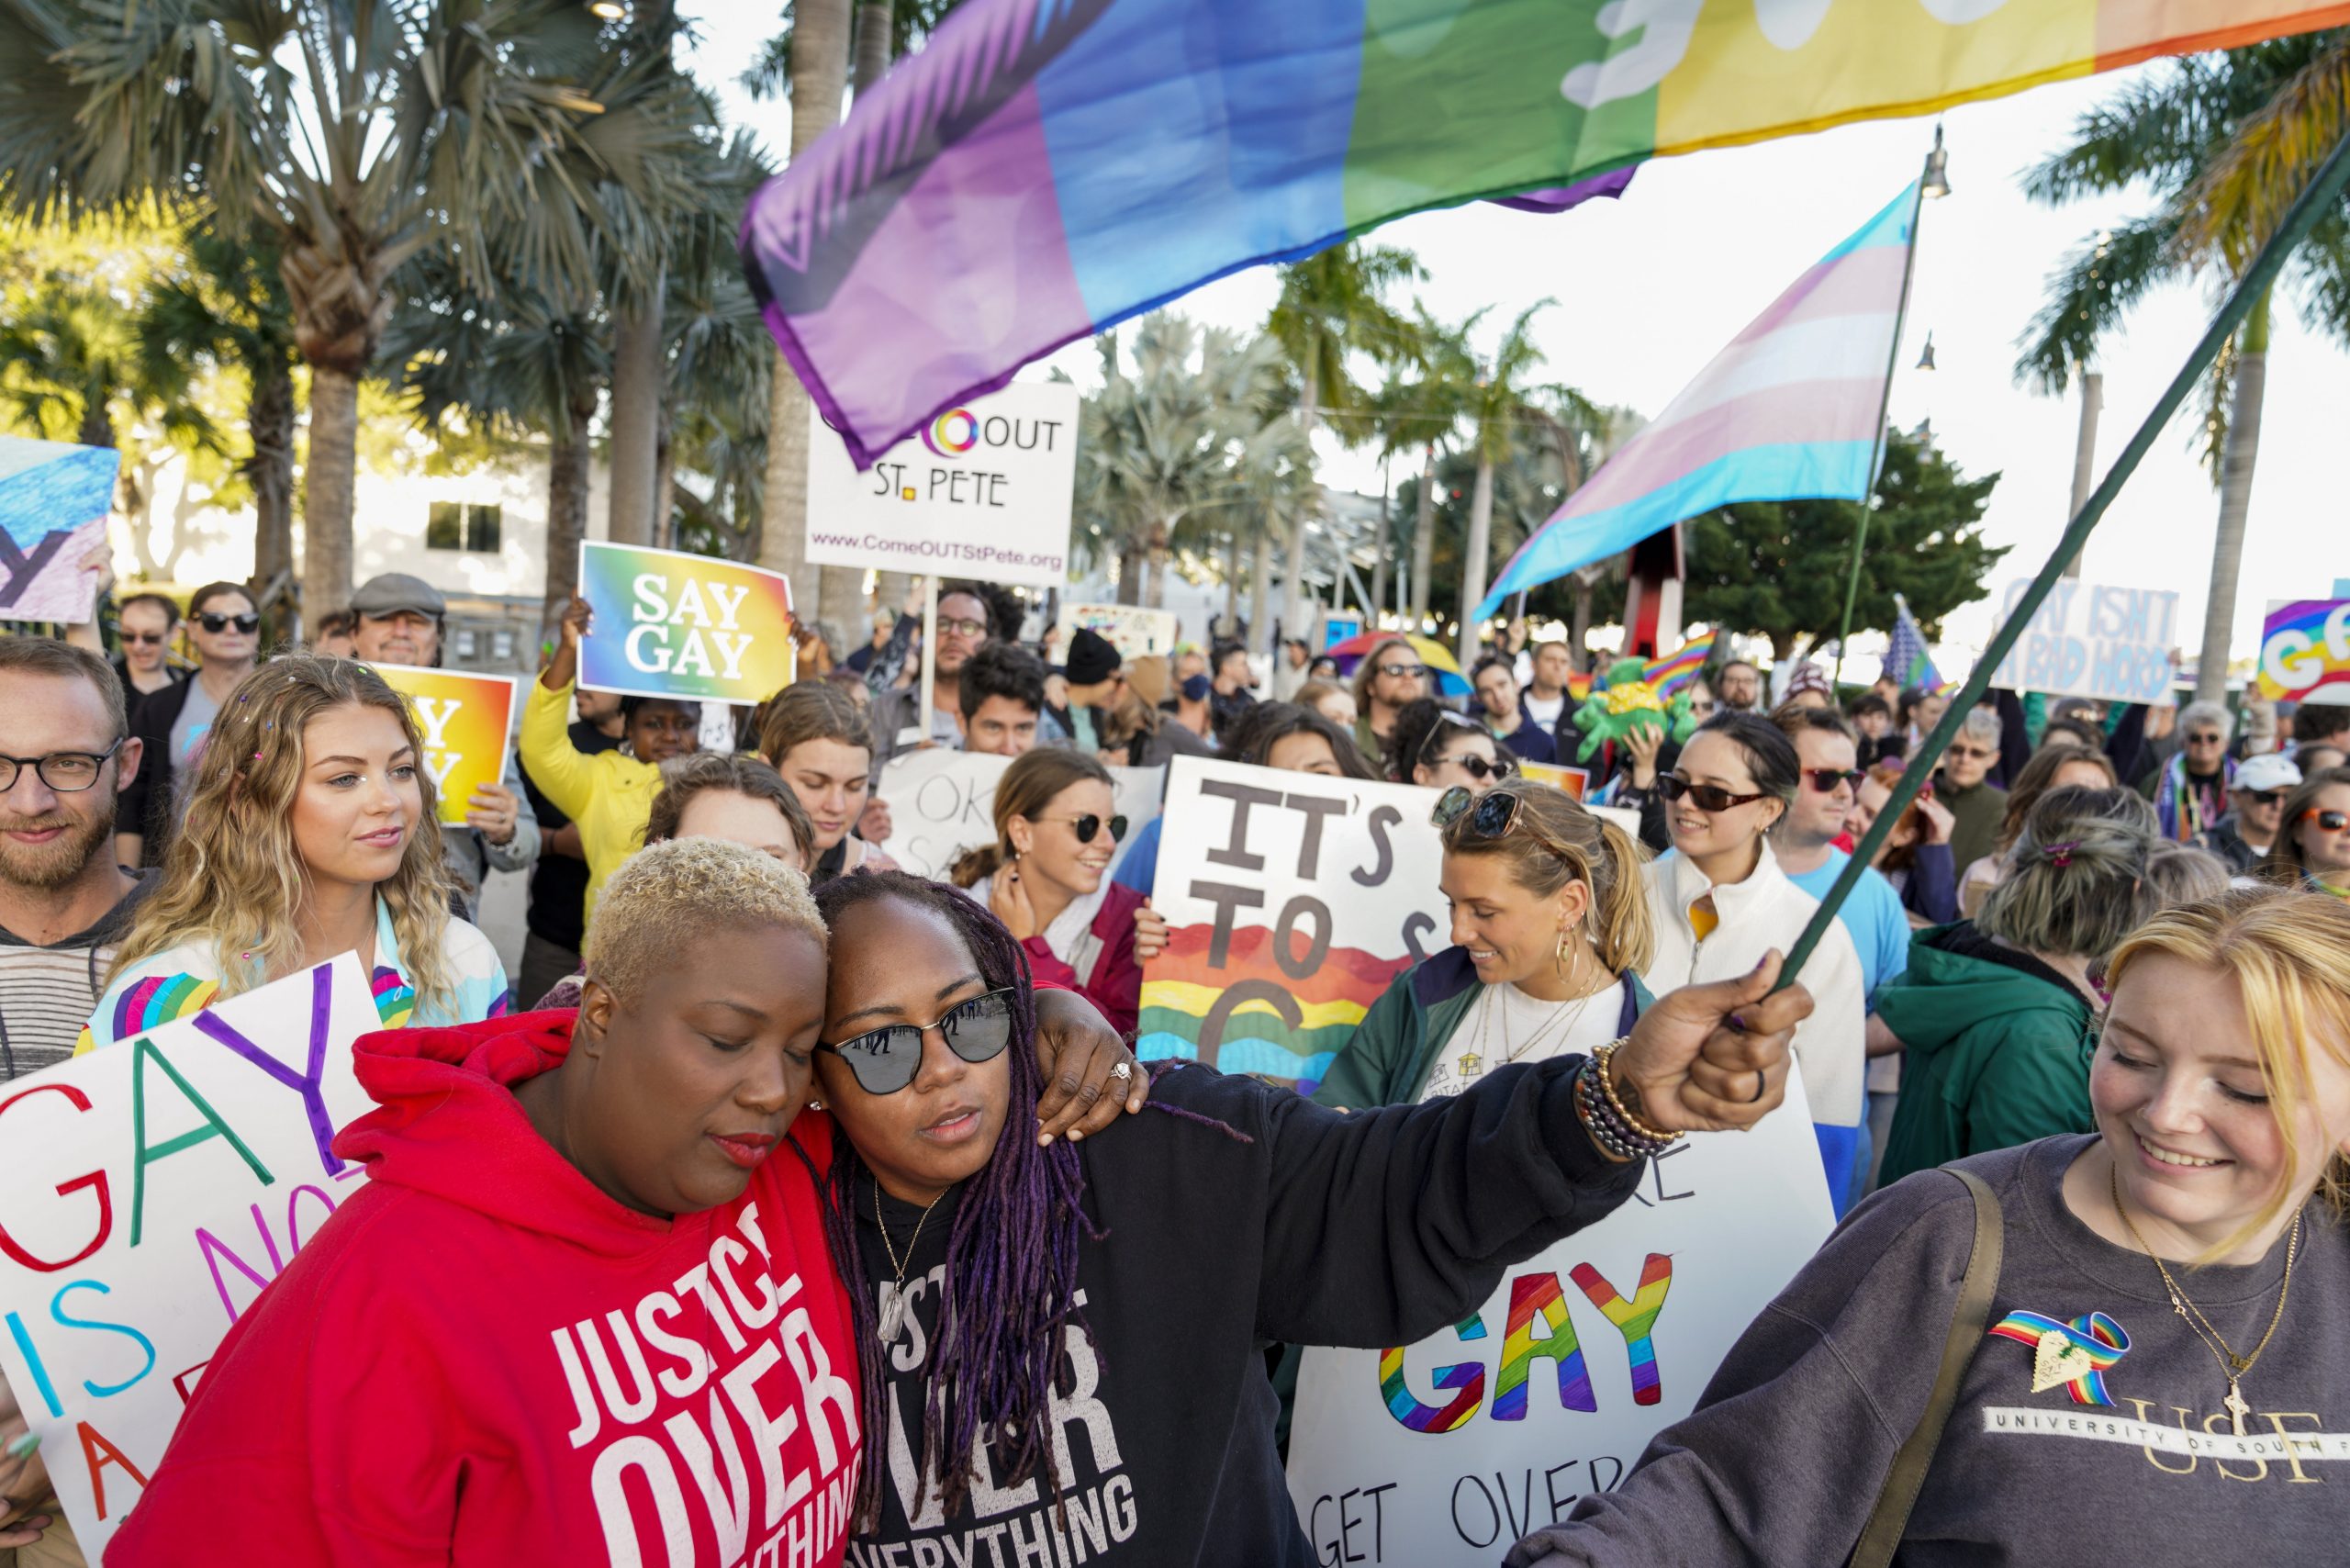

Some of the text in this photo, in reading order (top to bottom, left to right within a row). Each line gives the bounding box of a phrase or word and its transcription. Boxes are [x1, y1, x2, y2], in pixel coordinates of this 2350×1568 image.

[984, 416, 1062, 451] OUT
[874, 462, 1008, 507] ST. PETE
[811, 532, 1062, 572] www.ComeOUTStPete.org
[632, 573, 749, 631] SAY
[624, 623, 754, 680] GAY
[917, 774, 995, 826] OK
[1200, 778, 1403, 888] IT'S
[1190, 879, 1333, 980] TO
[0, 963, 346, 1272] GAY
[5, 1165, 367, 1418] IS NO
[1379, 1252, 1674, 1434] GAY
[859, 1324, 1124, 1531] VER
[1996, 1414, 2322, 1454] UNIVERSITY OF SOUTH
[2121, 1397, 2324, 1484] USF
[1311, 1482, 1398, 1568] GET
